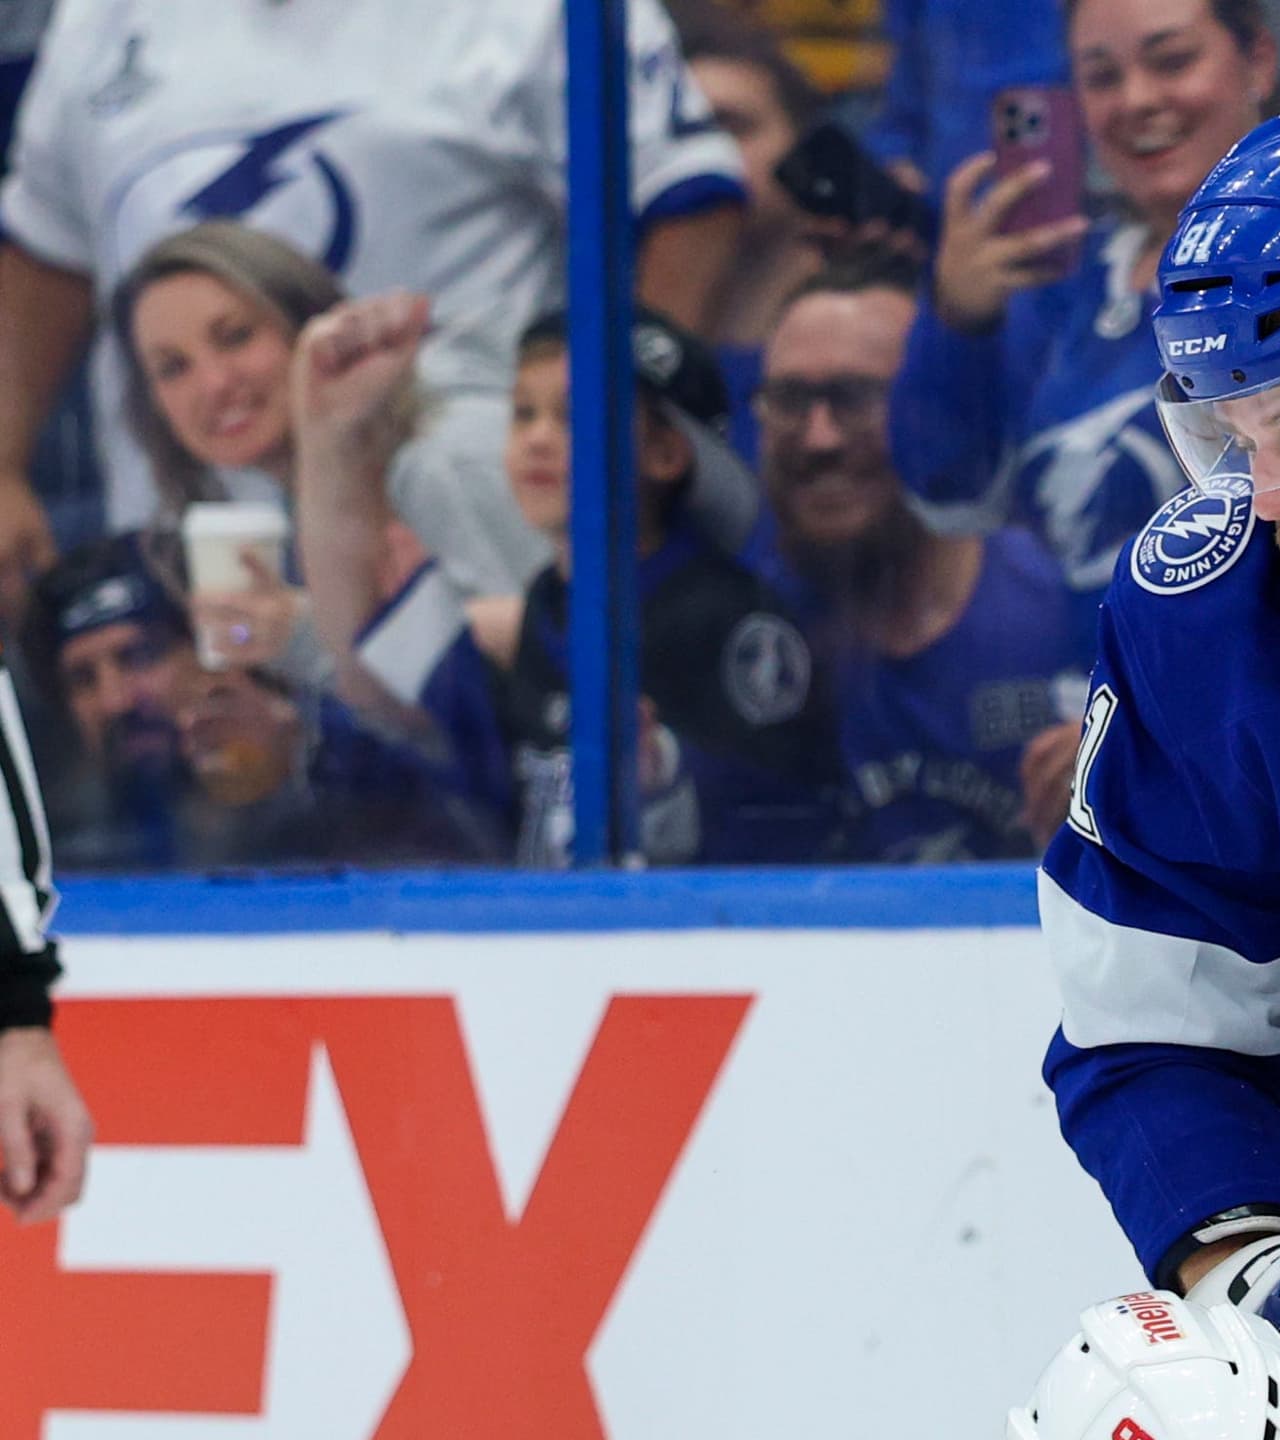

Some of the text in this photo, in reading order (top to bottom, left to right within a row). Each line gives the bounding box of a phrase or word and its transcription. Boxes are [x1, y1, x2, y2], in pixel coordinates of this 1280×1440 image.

[1173, 219, 1223, 265] 81
[1167, 333, 1228, 357] CCM
[1163, 502, 1249, 583] LIGHTNING
